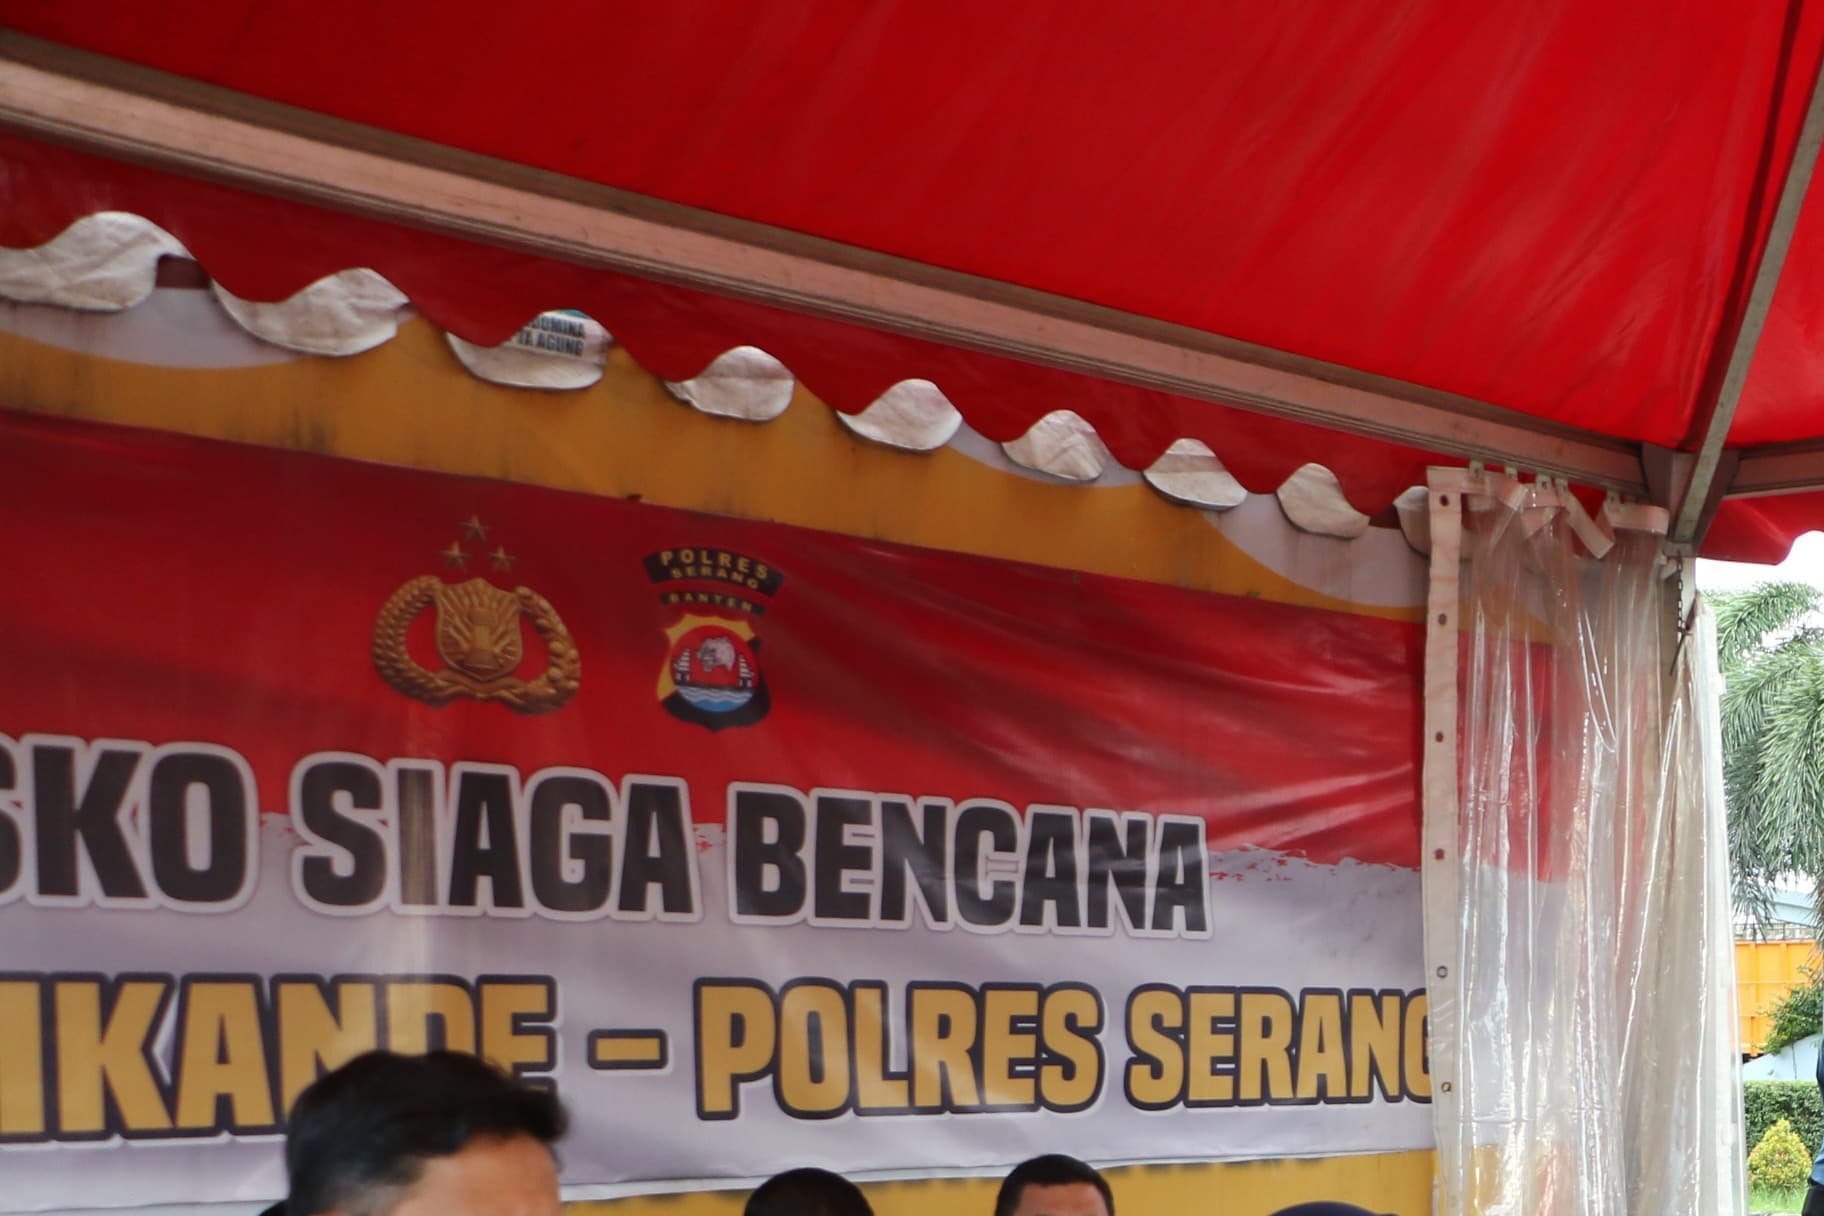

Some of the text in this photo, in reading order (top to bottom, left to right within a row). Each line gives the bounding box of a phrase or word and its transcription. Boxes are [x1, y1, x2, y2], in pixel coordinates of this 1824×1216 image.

[660, 549, 769, 580] POLRES
[670, 566, 759, 589] SERANG
[669, 592, 752, 611] BANTEN
[0, 736, 1211, 936] KO SIAGA BENCANA
[695, 978, 1105, 1121] POLRES
[1126, 985, 1434, 1110] SERANG
